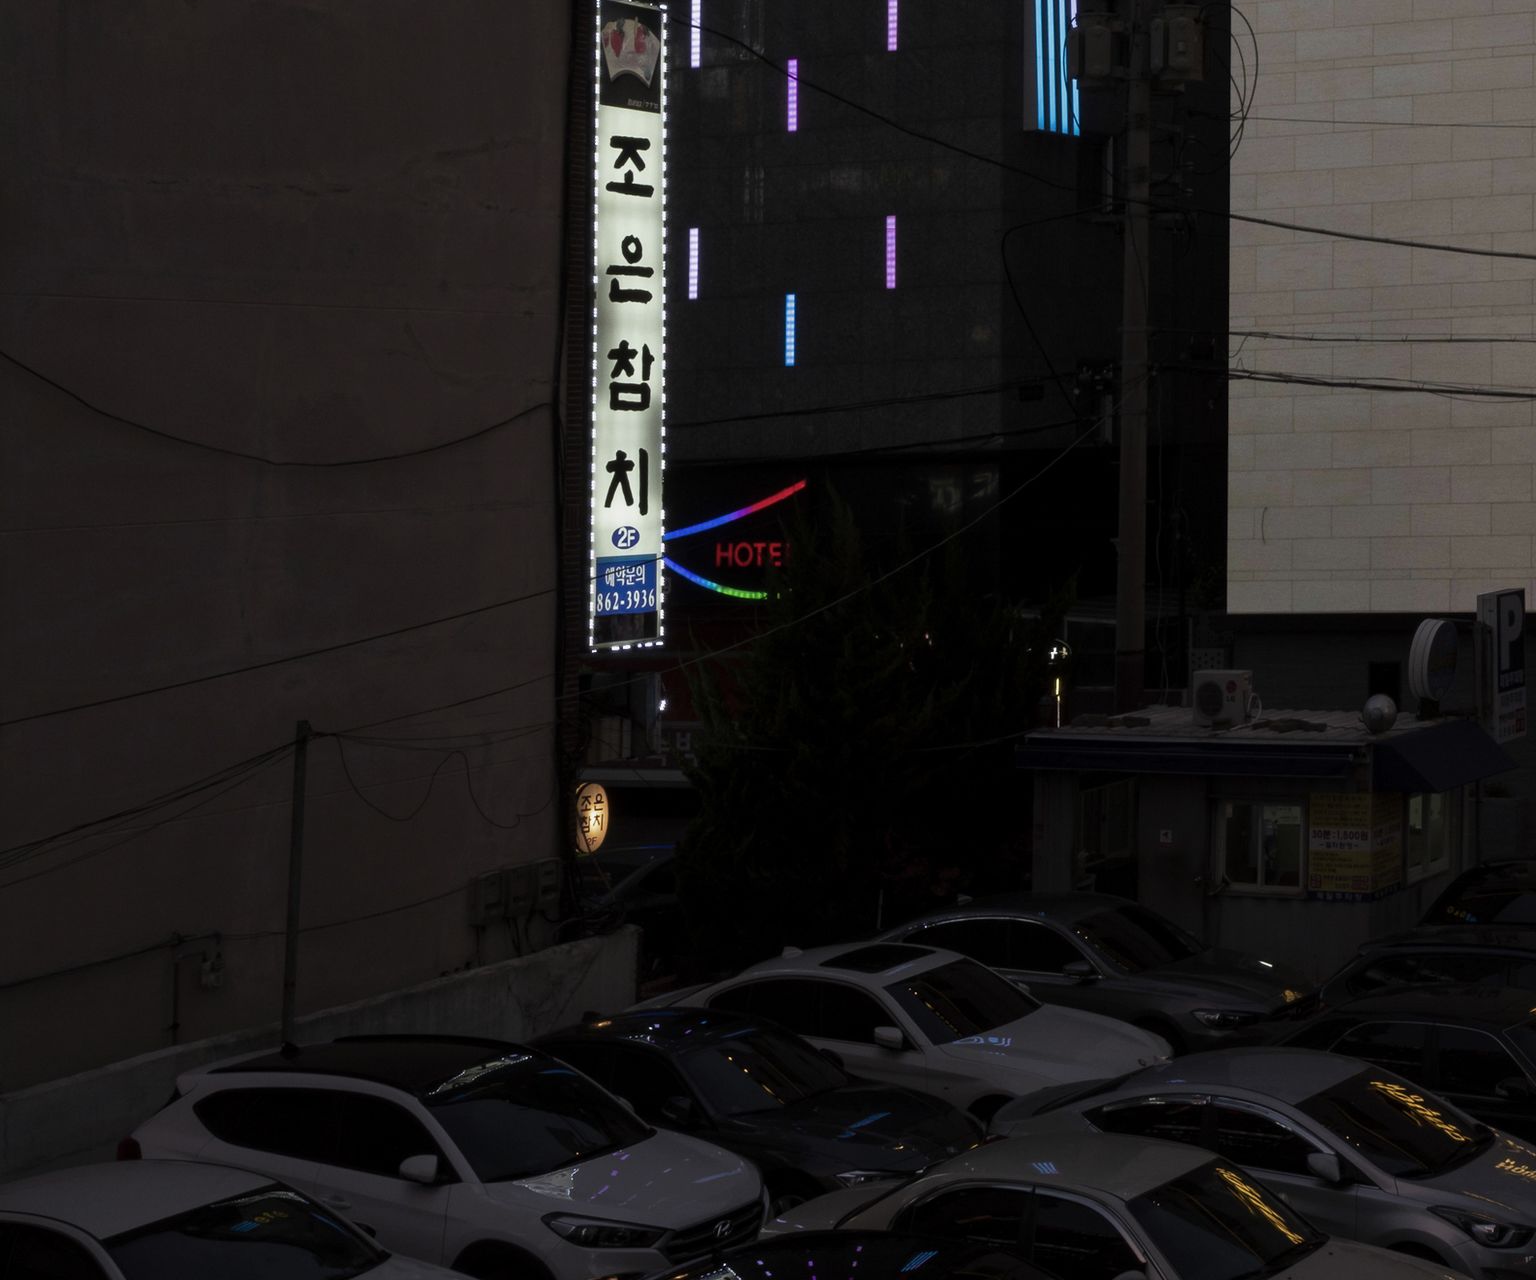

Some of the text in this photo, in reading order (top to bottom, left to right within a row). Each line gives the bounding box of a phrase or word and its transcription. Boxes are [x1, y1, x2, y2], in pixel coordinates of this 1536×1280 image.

[604, 135, 655, 516] 조은참치
[615, 527, 637, 548] 2F
[715, 542, 785, 567] HOTE
[604, 563, 646, 588] 예약문의
[596, 588, 656, 613] 862-3936
[1499, 594, 1523, 671] P
